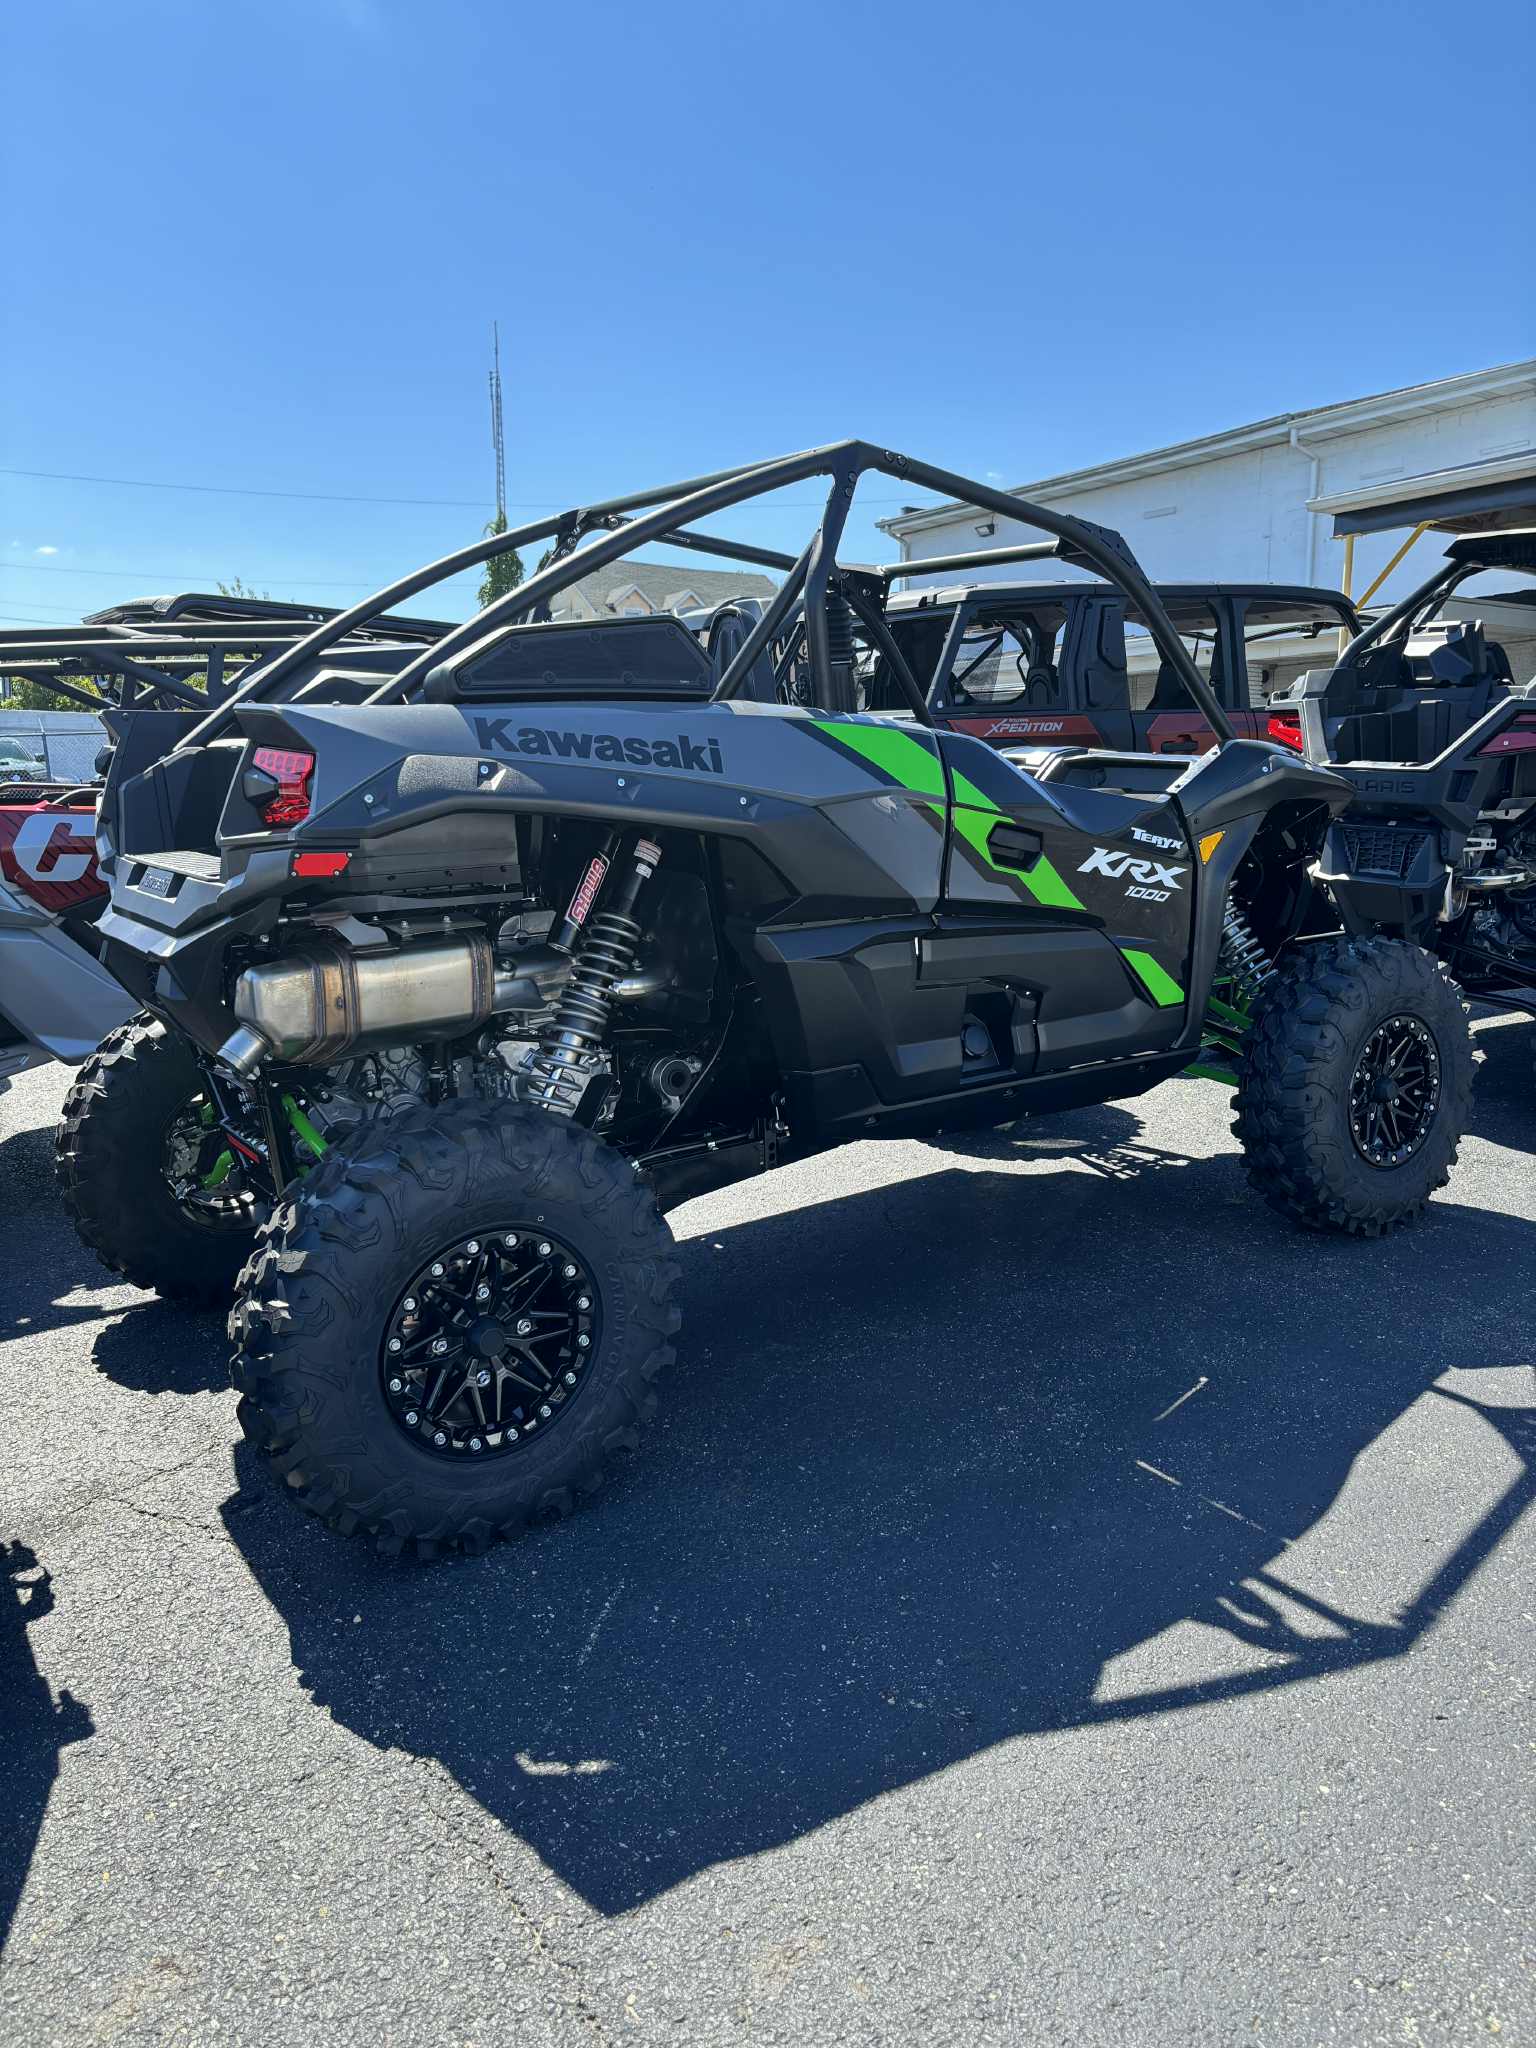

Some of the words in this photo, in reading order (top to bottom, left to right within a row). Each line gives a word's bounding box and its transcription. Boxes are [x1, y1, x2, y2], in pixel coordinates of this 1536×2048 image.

[984, 718, 1063, 736] XPEDITION
[474, 717, 724, 774] Kawasaki
[1354, 780, 1416, 793] LARIS
[1076, 847, 1188, 889] KRX
[1124, 885, 1172, 902] 1000
